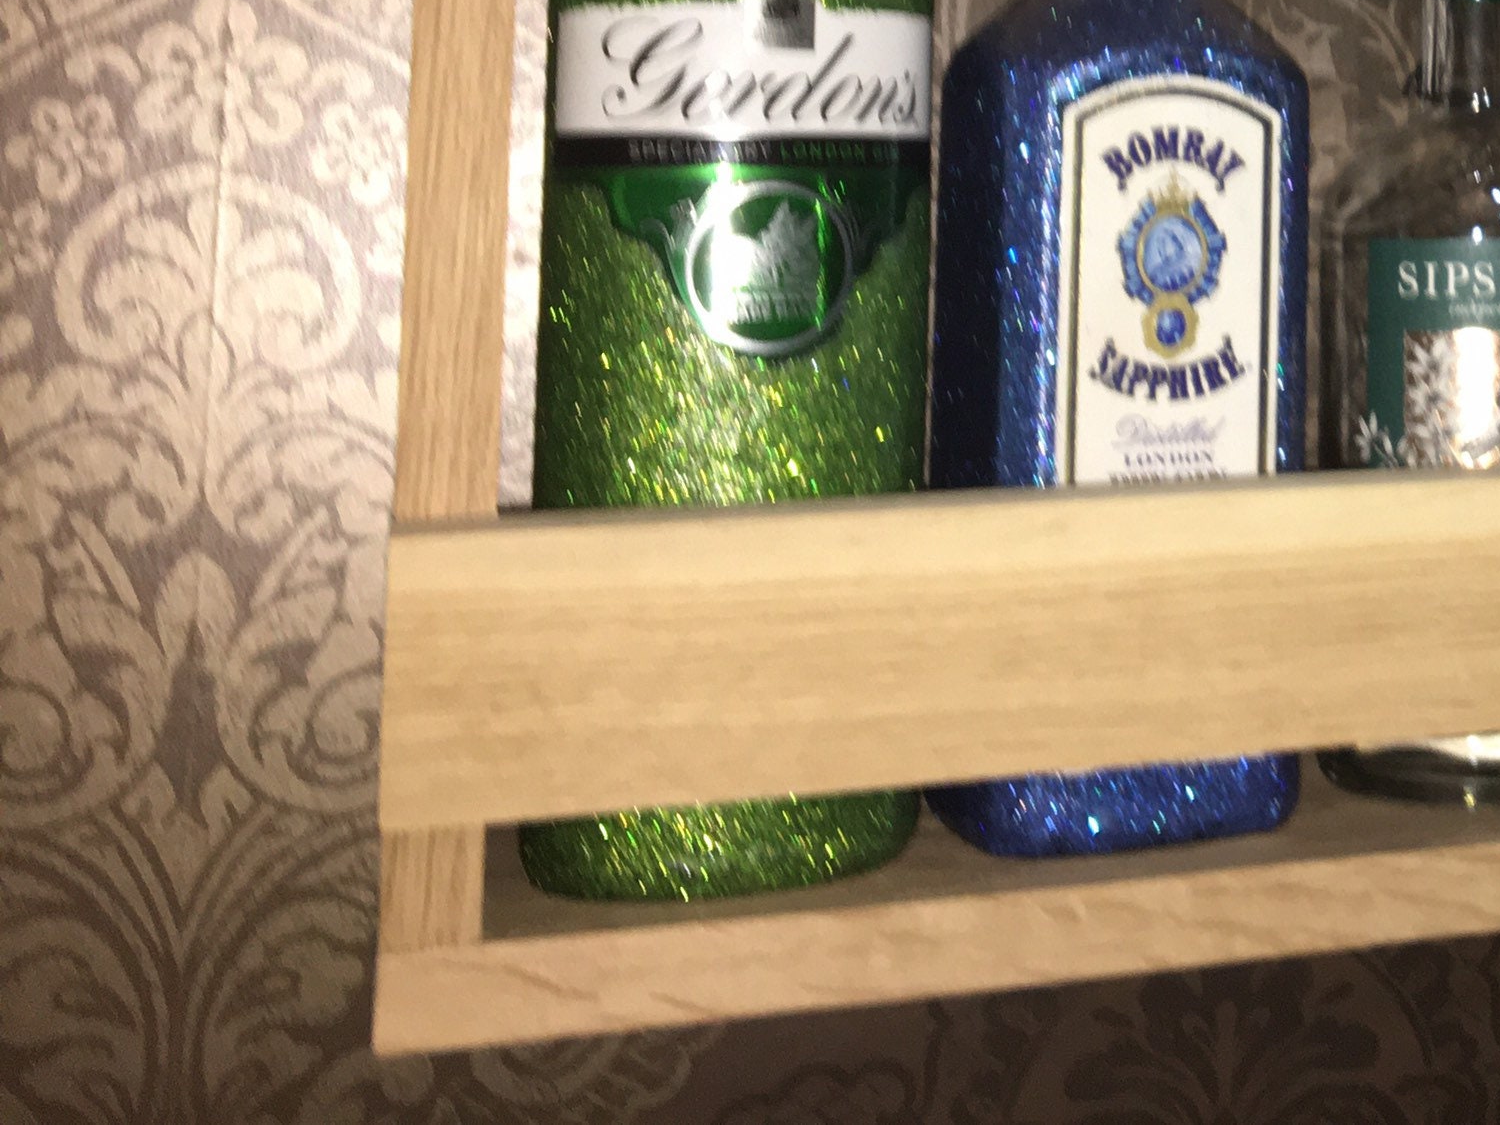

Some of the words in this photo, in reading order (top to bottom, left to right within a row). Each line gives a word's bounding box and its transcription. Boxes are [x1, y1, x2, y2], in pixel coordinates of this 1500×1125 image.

[601, 13, 919, 125] Gordon's
[1100, 124, 1247, 195] BOMBAY
[1088, 333, 1248, 401] SAPPHIRE
